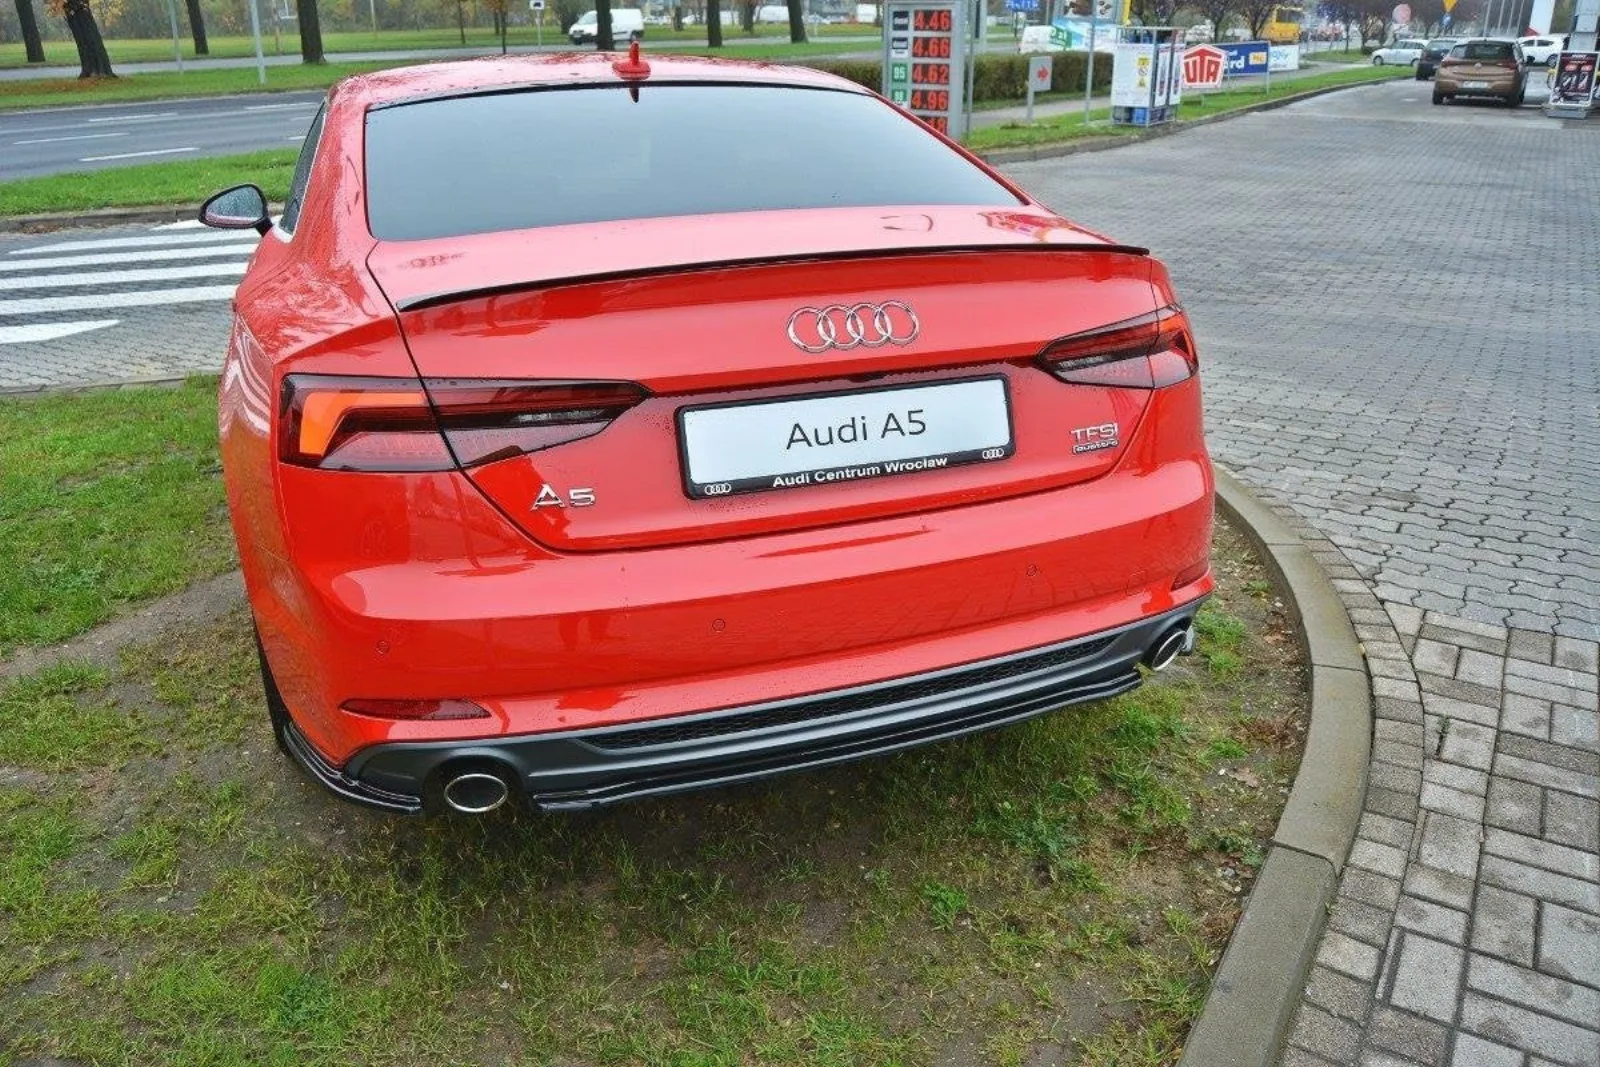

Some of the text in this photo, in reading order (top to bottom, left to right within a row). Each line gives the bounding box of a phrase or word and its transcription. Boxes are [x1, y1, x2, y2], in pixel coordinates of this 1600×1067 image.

[915, 11, 950, 30] 4.46
[914, 38, 950, 57] 4.66
[913, 64, 949, 83] 4.62
[1183, 49, 1222, 83] UTA
[786, 409, 927, 450] Audi A5
[1070, 423, 1118, 442] TFSI
[772, 473, 810, 487] Audi
[814, 464, 881, 482] Centrum
[530, 483, 597, 511] A5
